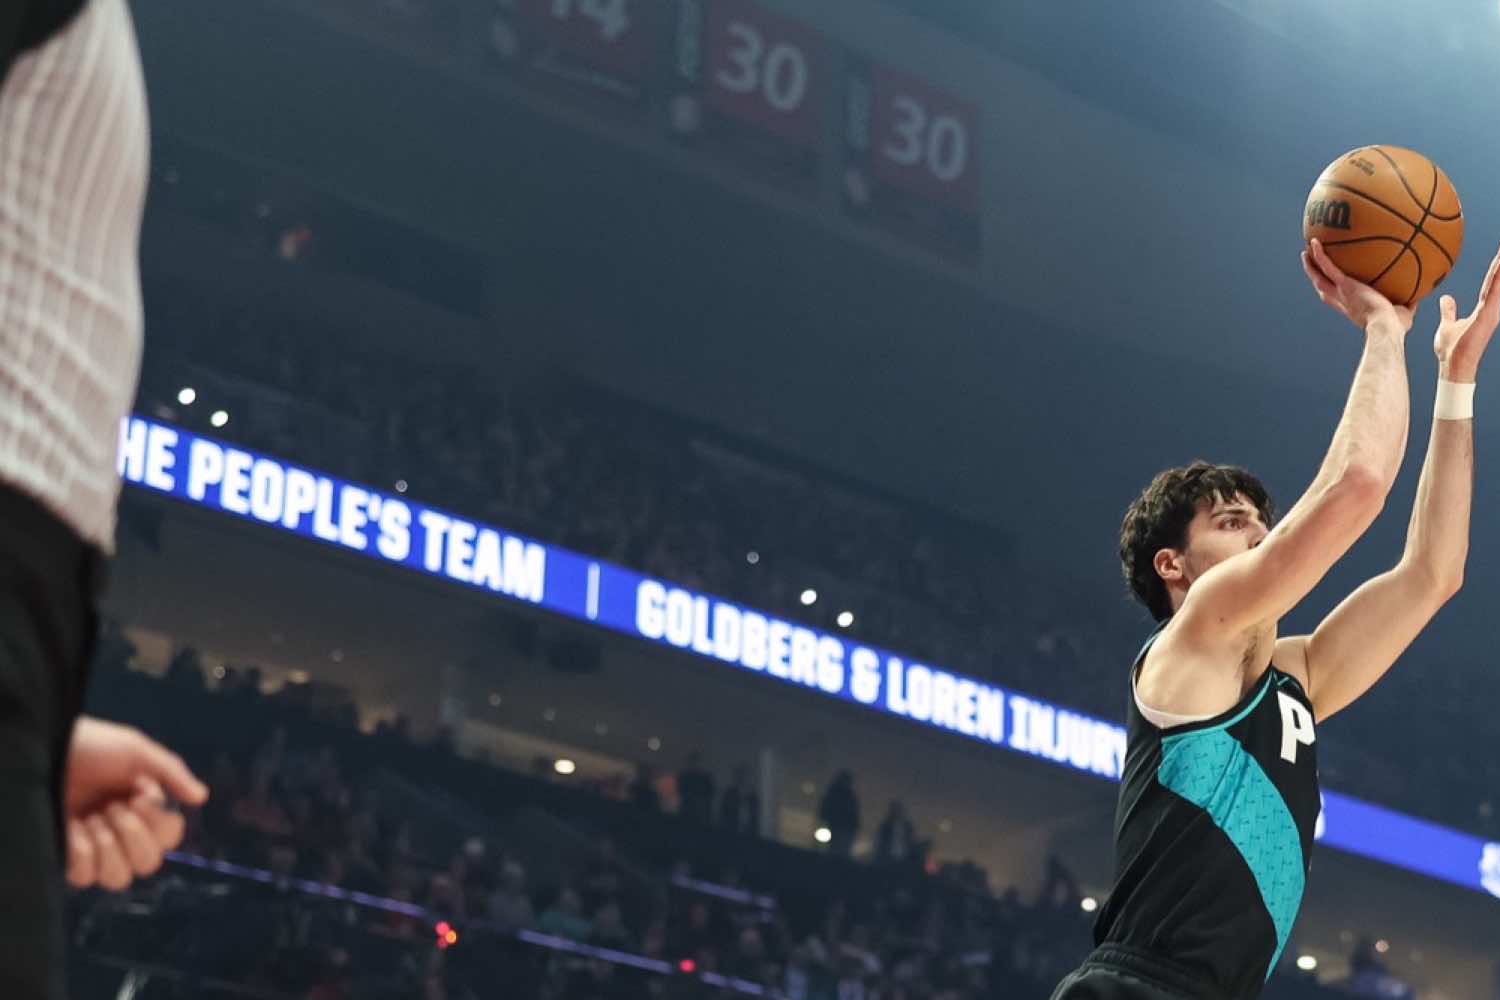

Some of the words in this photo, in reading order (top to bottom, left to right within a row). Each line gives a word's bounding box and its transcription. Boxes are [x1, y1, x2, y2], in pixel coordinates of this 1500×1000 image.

[716, 22, 806, 110] 30
[884, 96, 966, 180] 30
[117, 415, 178, 492] HE
[187, 437, 412, 562] PEOPLE'S
[418, 509, 547, 604] TEAM
[635, 578, 845, 695] GOLDBERG
[849, 645, 881, 704] &
[885, 655, 1004, 744] LOREN
